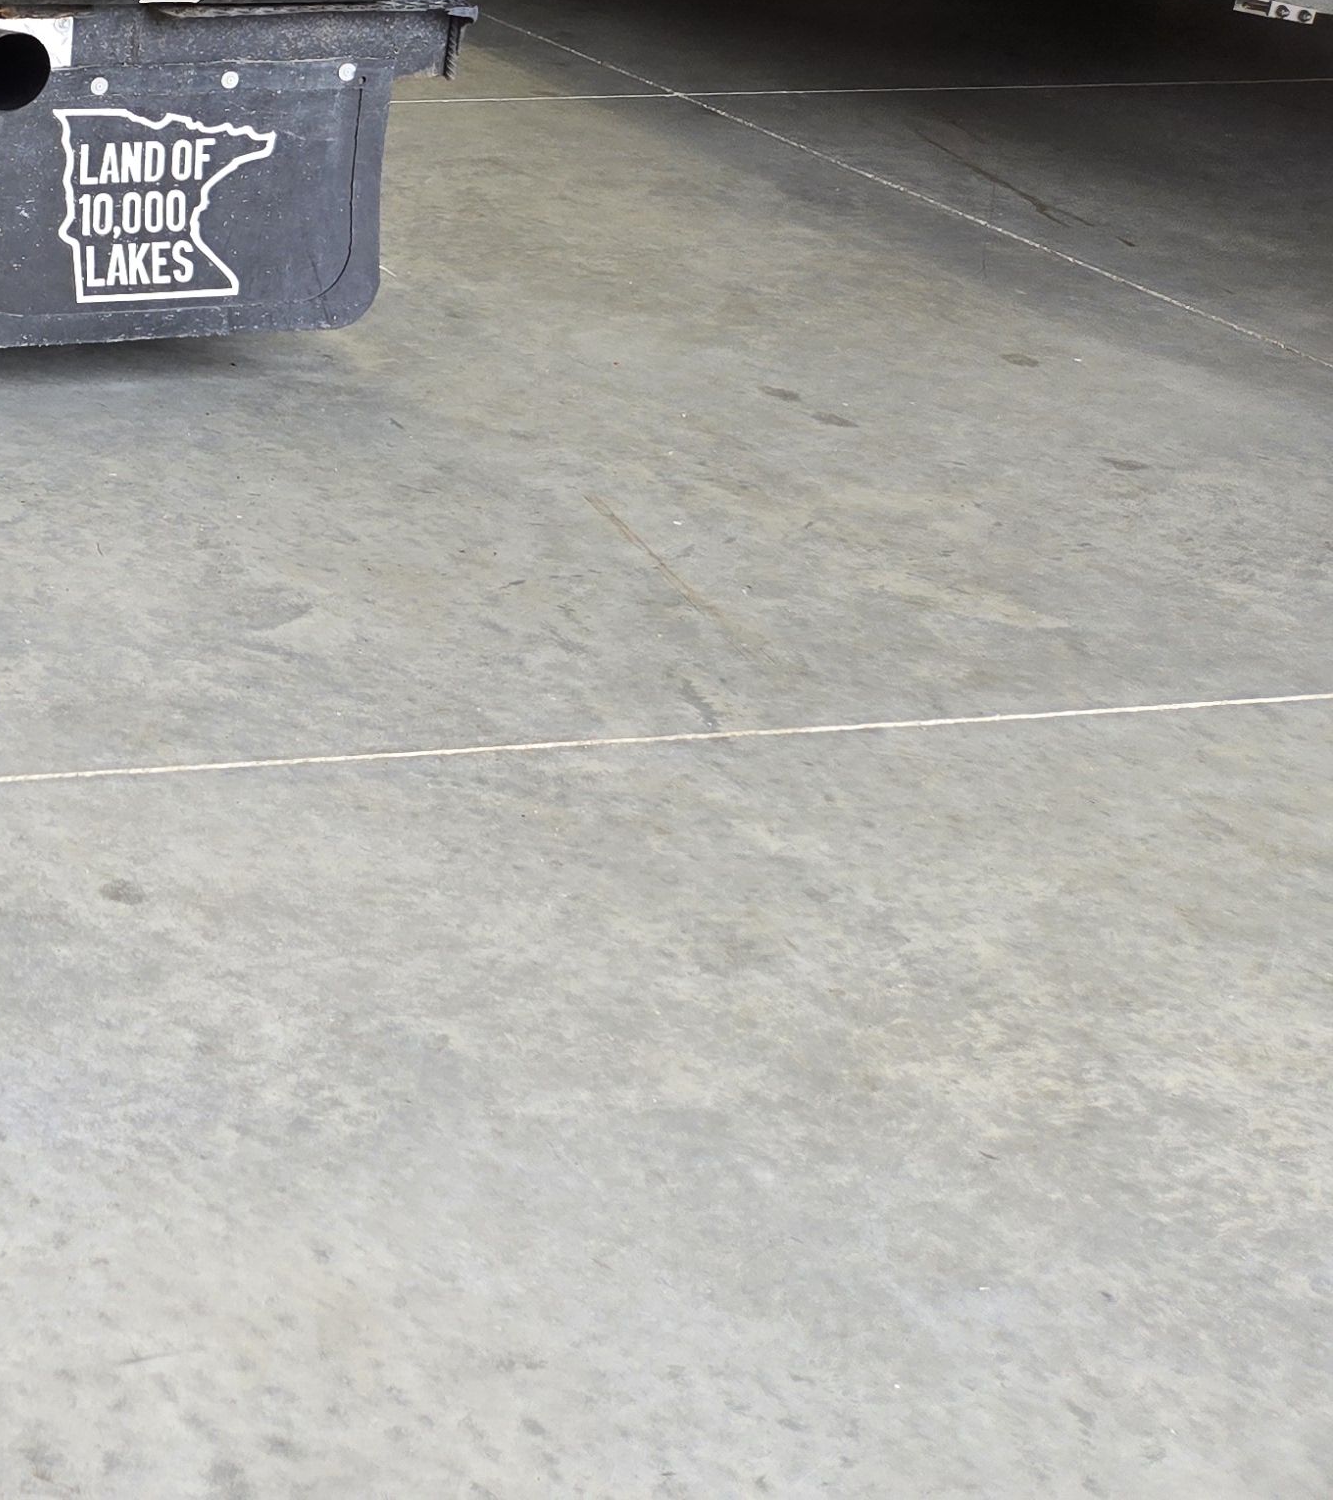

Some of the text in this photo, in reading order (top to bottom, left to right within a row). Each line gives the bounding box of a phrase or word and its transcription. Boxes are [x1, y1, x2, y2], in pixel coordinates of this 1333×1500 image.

[79, 138, 216, 185] LAND OF
[78, 189, 186, 239] 10,000
[85, 240, 194, 288] LAKES
